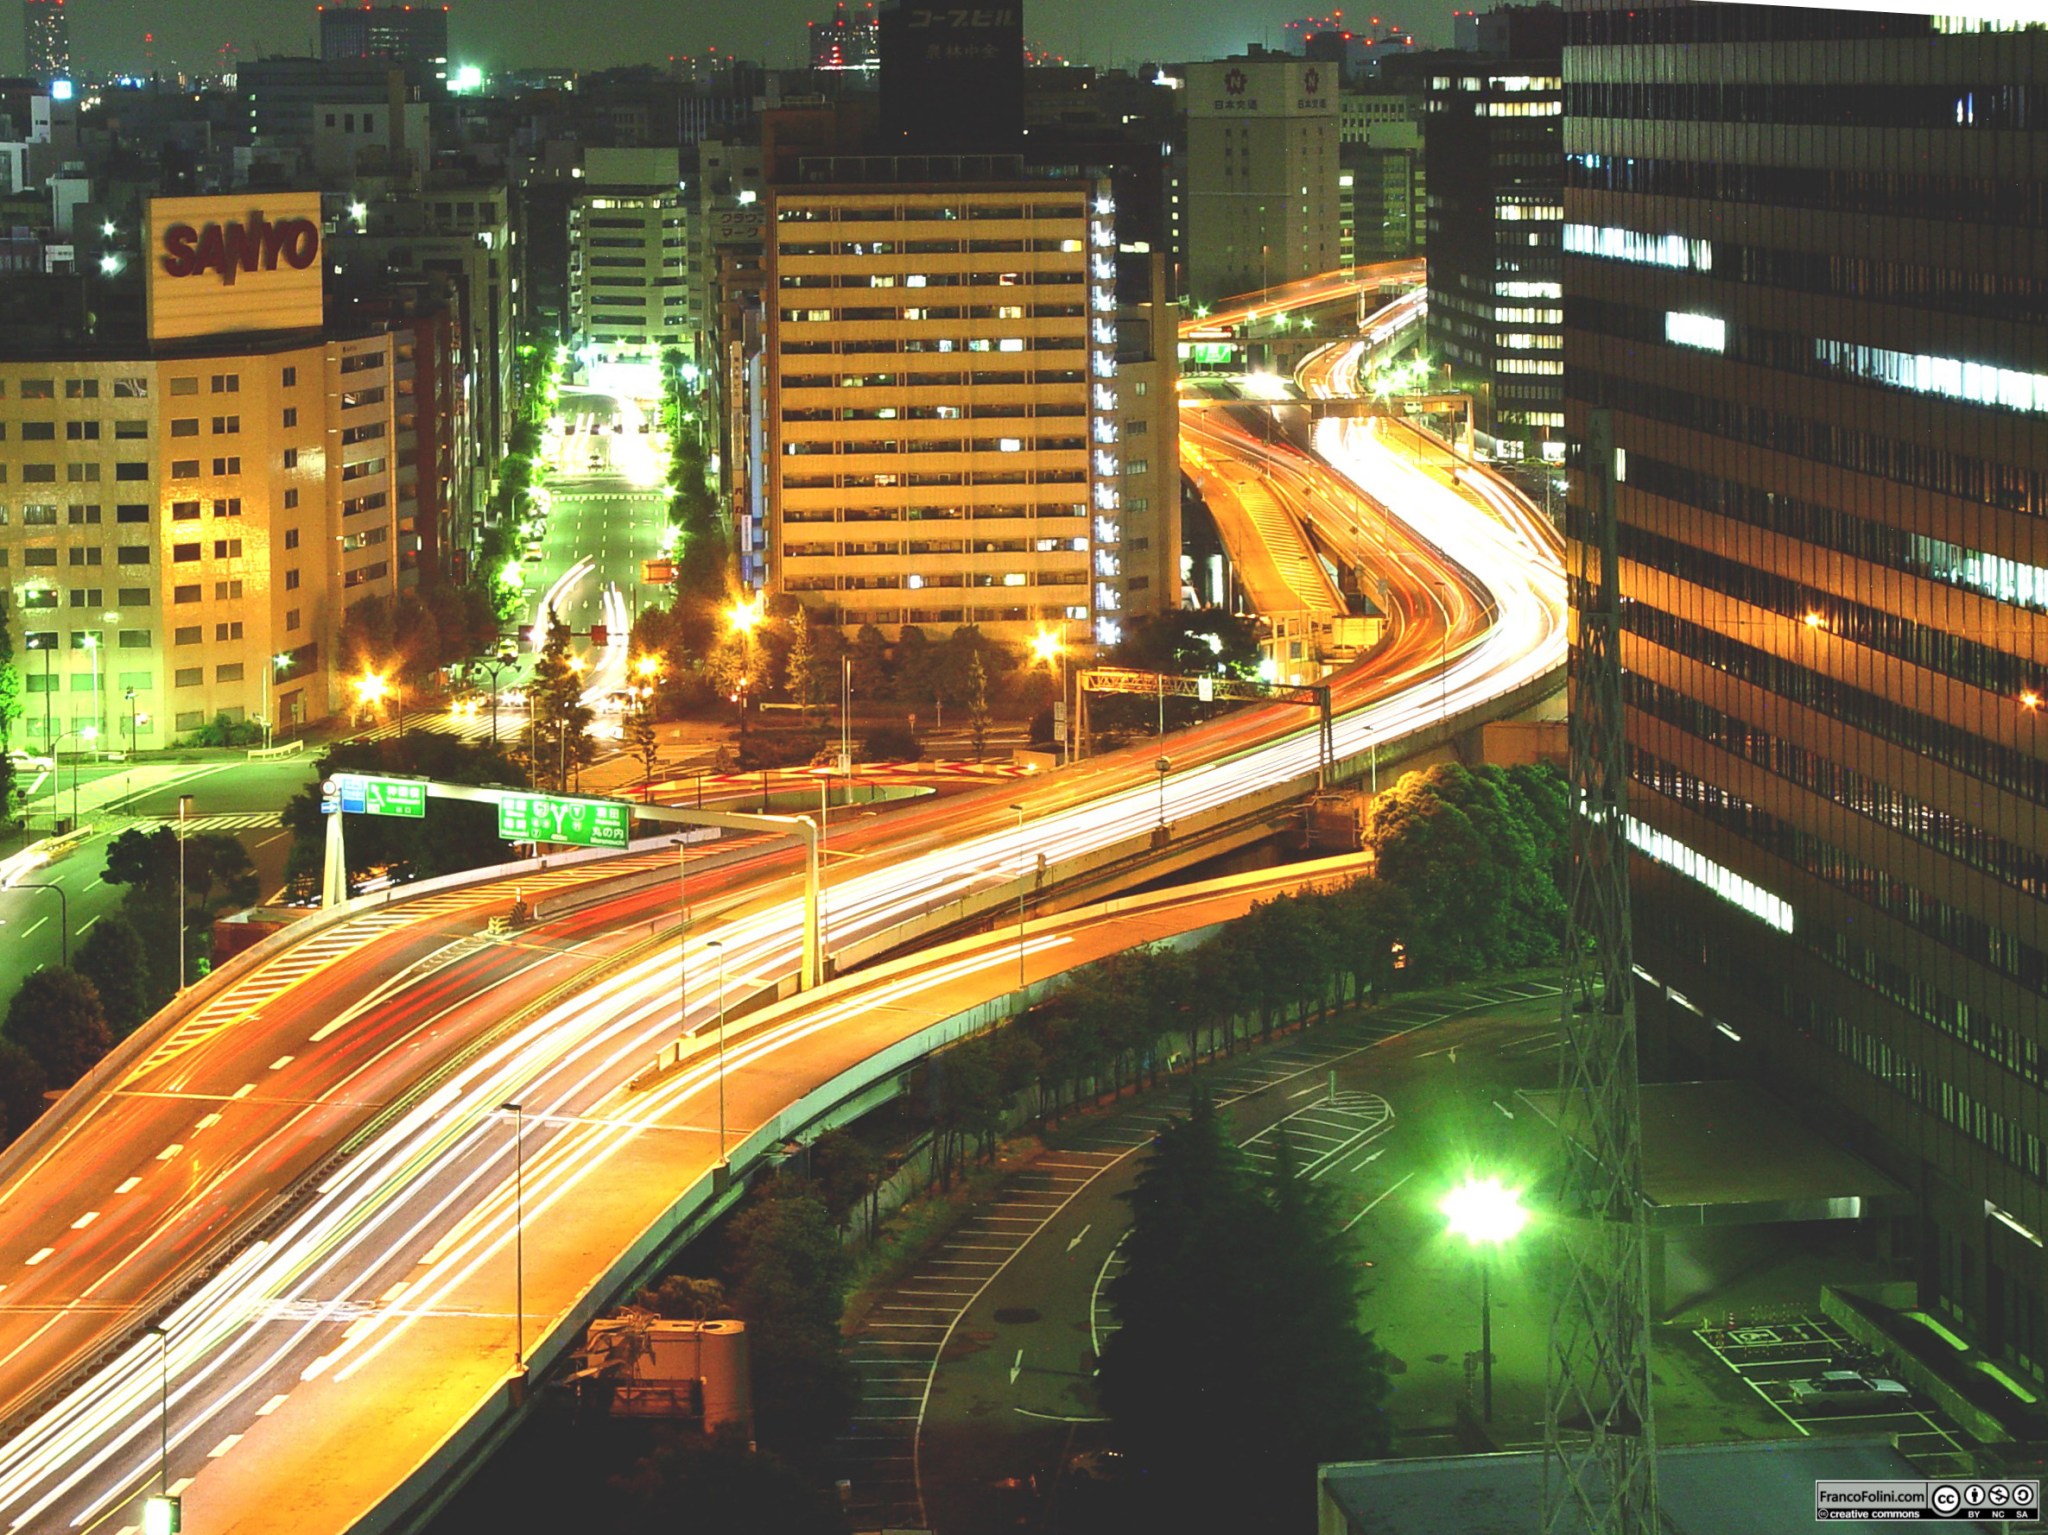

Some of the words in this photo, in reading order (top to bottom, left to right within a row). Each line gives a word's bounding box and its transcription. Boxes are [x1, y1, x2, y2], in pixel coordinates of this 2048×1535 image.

[163, 209, 319, 286] SANYO
[592, 827, 624, 839] 丸の内
